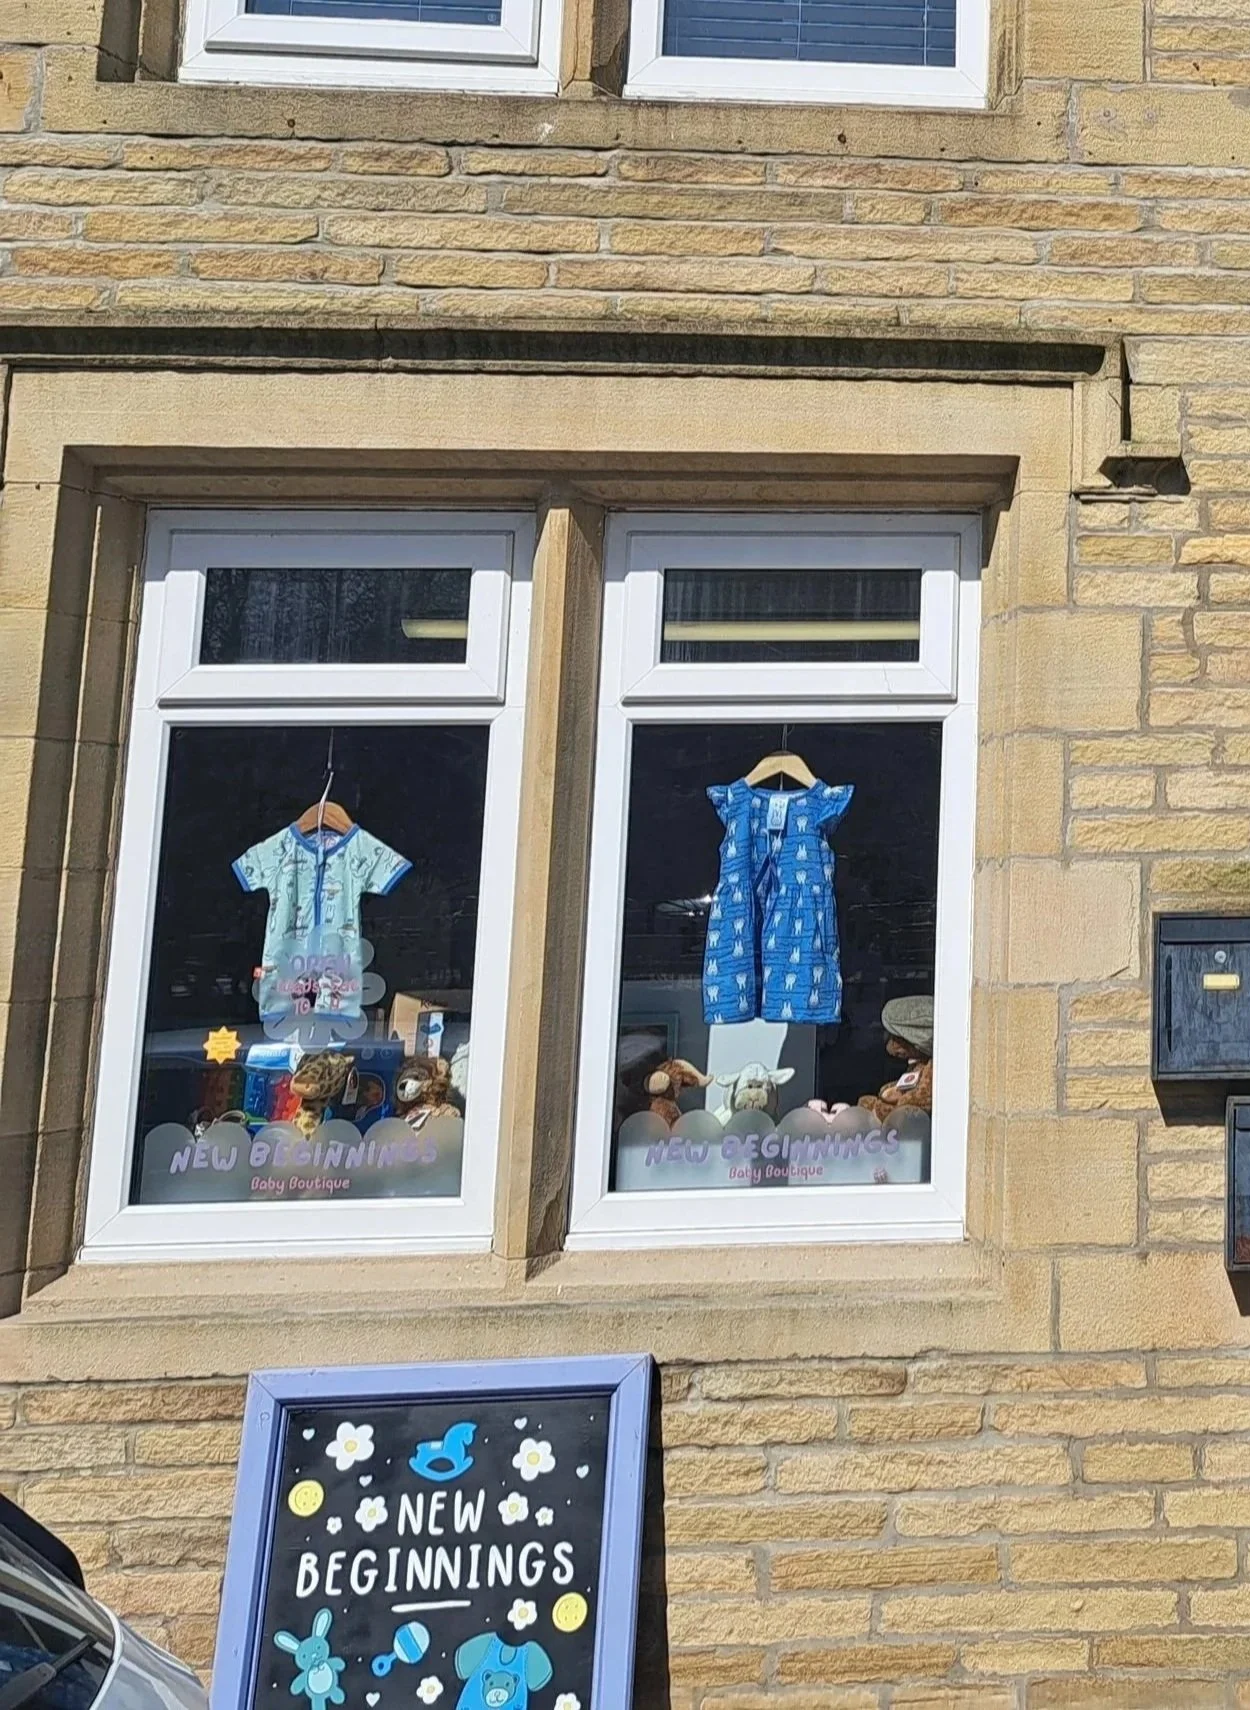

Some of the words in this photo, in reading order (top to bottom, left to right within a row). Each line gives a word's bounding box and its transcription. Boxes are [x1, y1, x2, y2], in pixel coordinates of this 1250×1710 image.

[170, 1142, 237, 1175] NEW
[249, 1136, 438, 1170] BEGINNINGS
[645, 1137, 710, 1168] NEW
[721, 1129, 900, 1161] BEGINNINGS
[251, 1176, 286, 1195] Baby
[289, 1175, 351, 1195] Boutique
[728, 1166, 762, 1184] Baby
[766, 1164, 824, 1183] Boutique
[398, 1489, 486, 1536] NEW
[295, 1541, 575, 1598] BEGINNINGS
